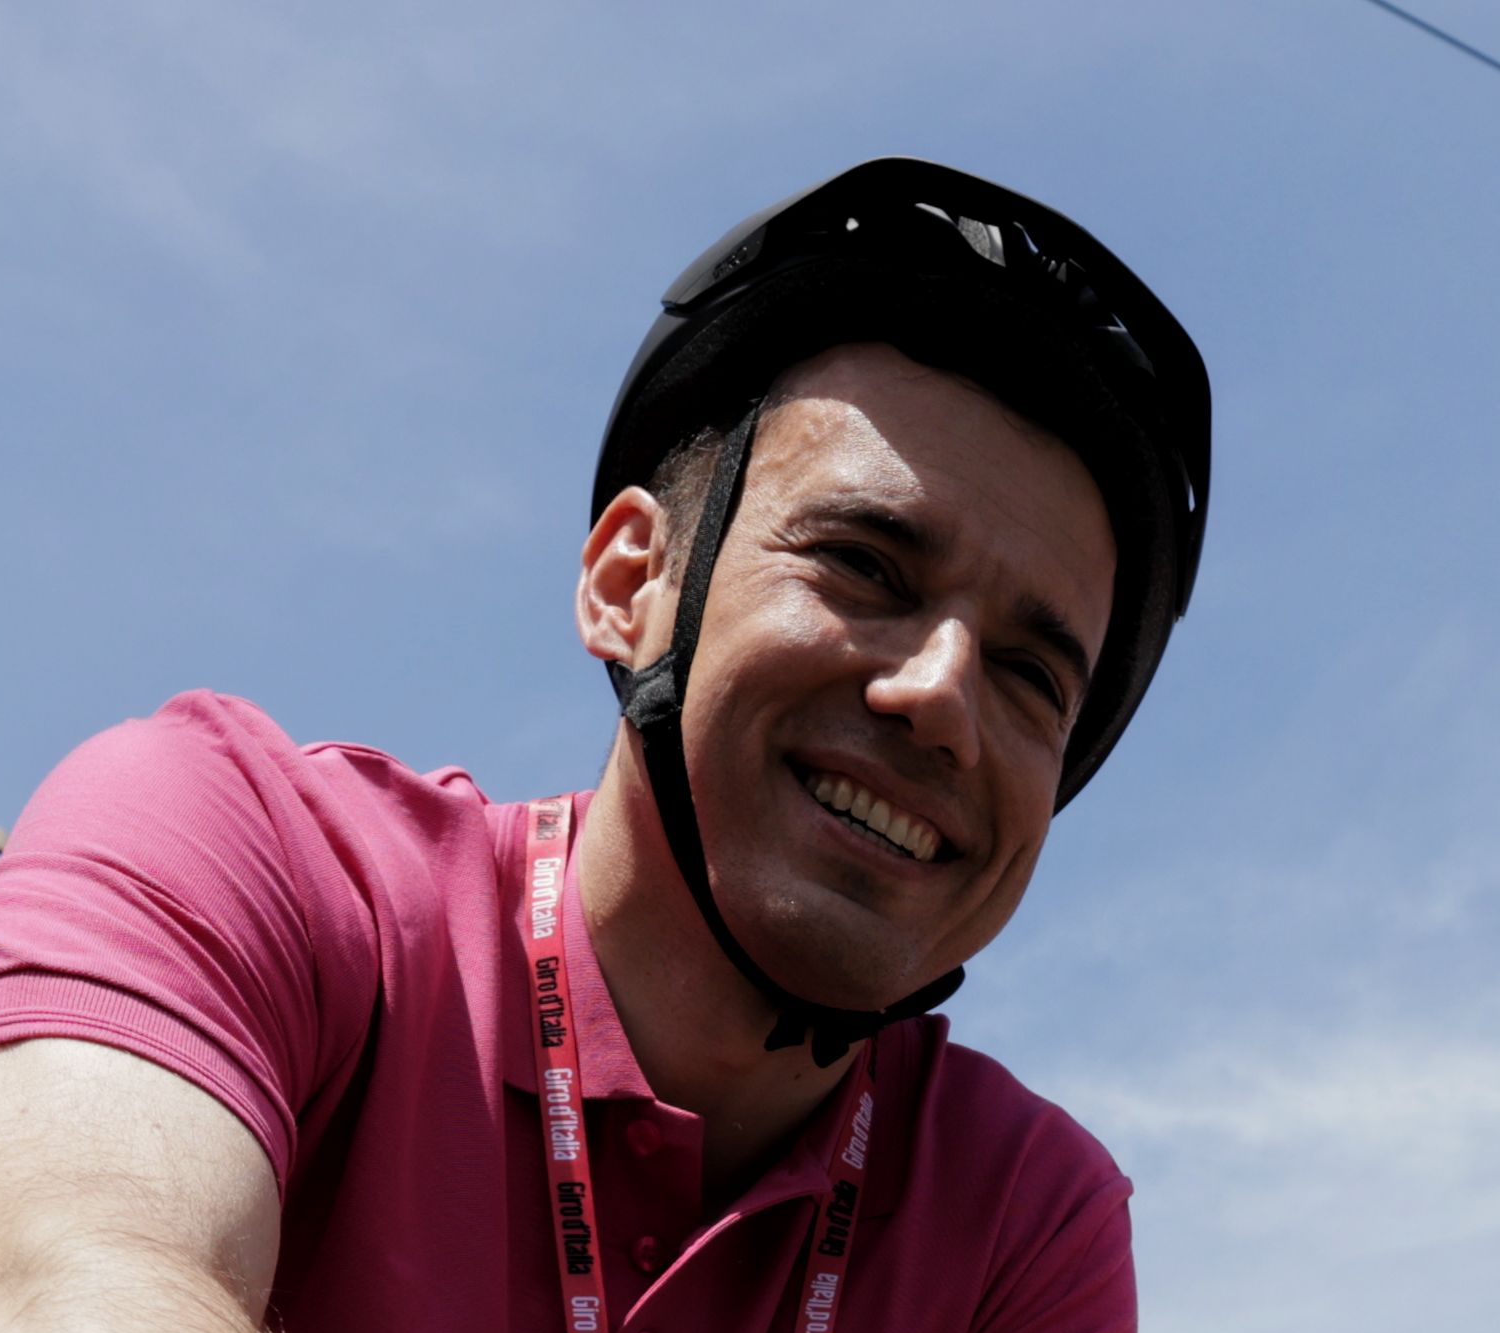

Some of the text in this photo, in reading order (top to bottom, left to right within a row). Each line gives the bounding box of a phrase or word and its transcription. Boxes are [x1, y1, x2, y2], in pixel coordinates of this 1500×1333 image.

[533, 857, 562, 887] Giro
[535, 956, 559, 992] Giro
[544, 1067, 572, 1103] Giro
[842, 1136, 866, 1170] Giro
[557, 1182, 585, 1216] Giro
[571, 1296, 600, 1331] Giro
